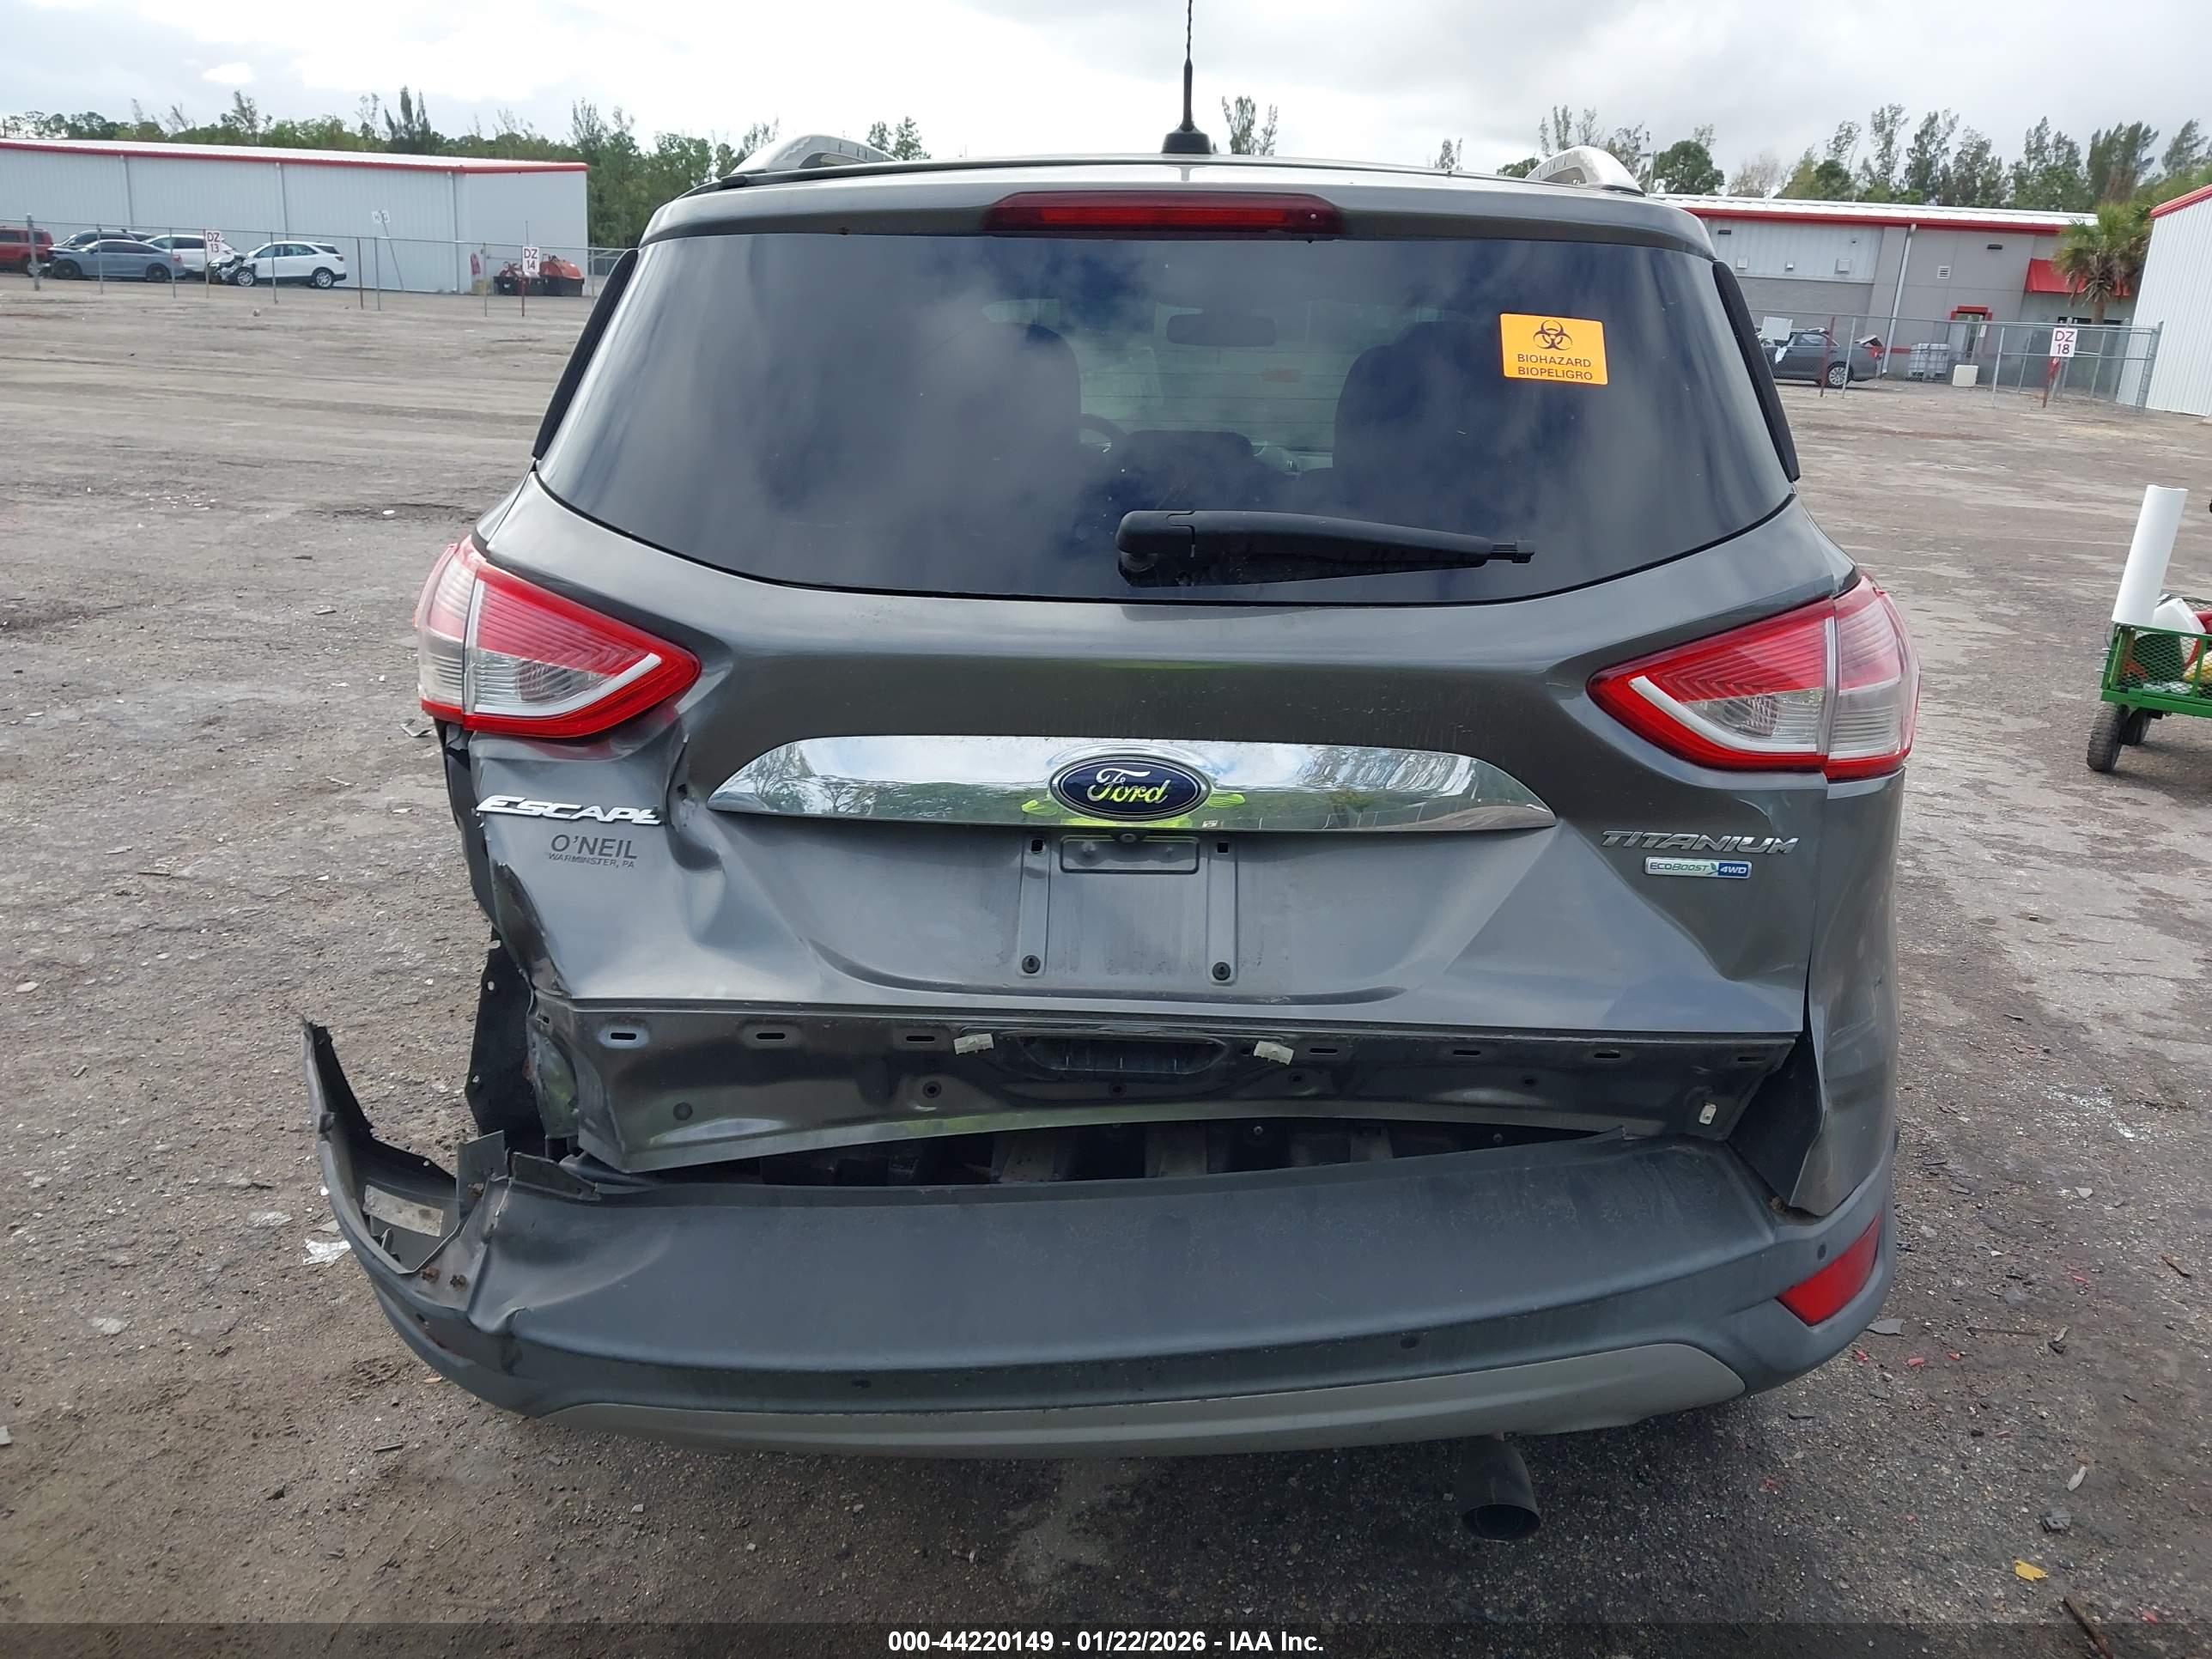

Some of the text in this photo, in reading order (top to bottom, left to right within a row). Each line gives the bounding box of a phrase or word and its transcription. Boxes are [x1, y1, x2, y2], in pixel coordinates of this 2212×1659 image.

[207, 232, 221, 242] DZ
[210, 243, 220, 253] 13
[524, 248, 538, 259] DZ
[526, 259, 536, 270] 14
[2054, 330, 2075, 343] DZ
[2057, 343, 2070, 355] 18
[1517, 353, 1591, 368] BIOHAZARD
[1518, 366, 1593, 380] BIOPELIGRO
[1086, 768, 1171, 804] Ford
[476, 795, 661, 825] ESCAPE
[550, 833, 638, 859] O'NEIL
[1600, 830, 1800, 854] TITANIUM
[548, 852, 635, 868] WARMINSTER, PA
[1720, 865, 1747, 874] 4WD
